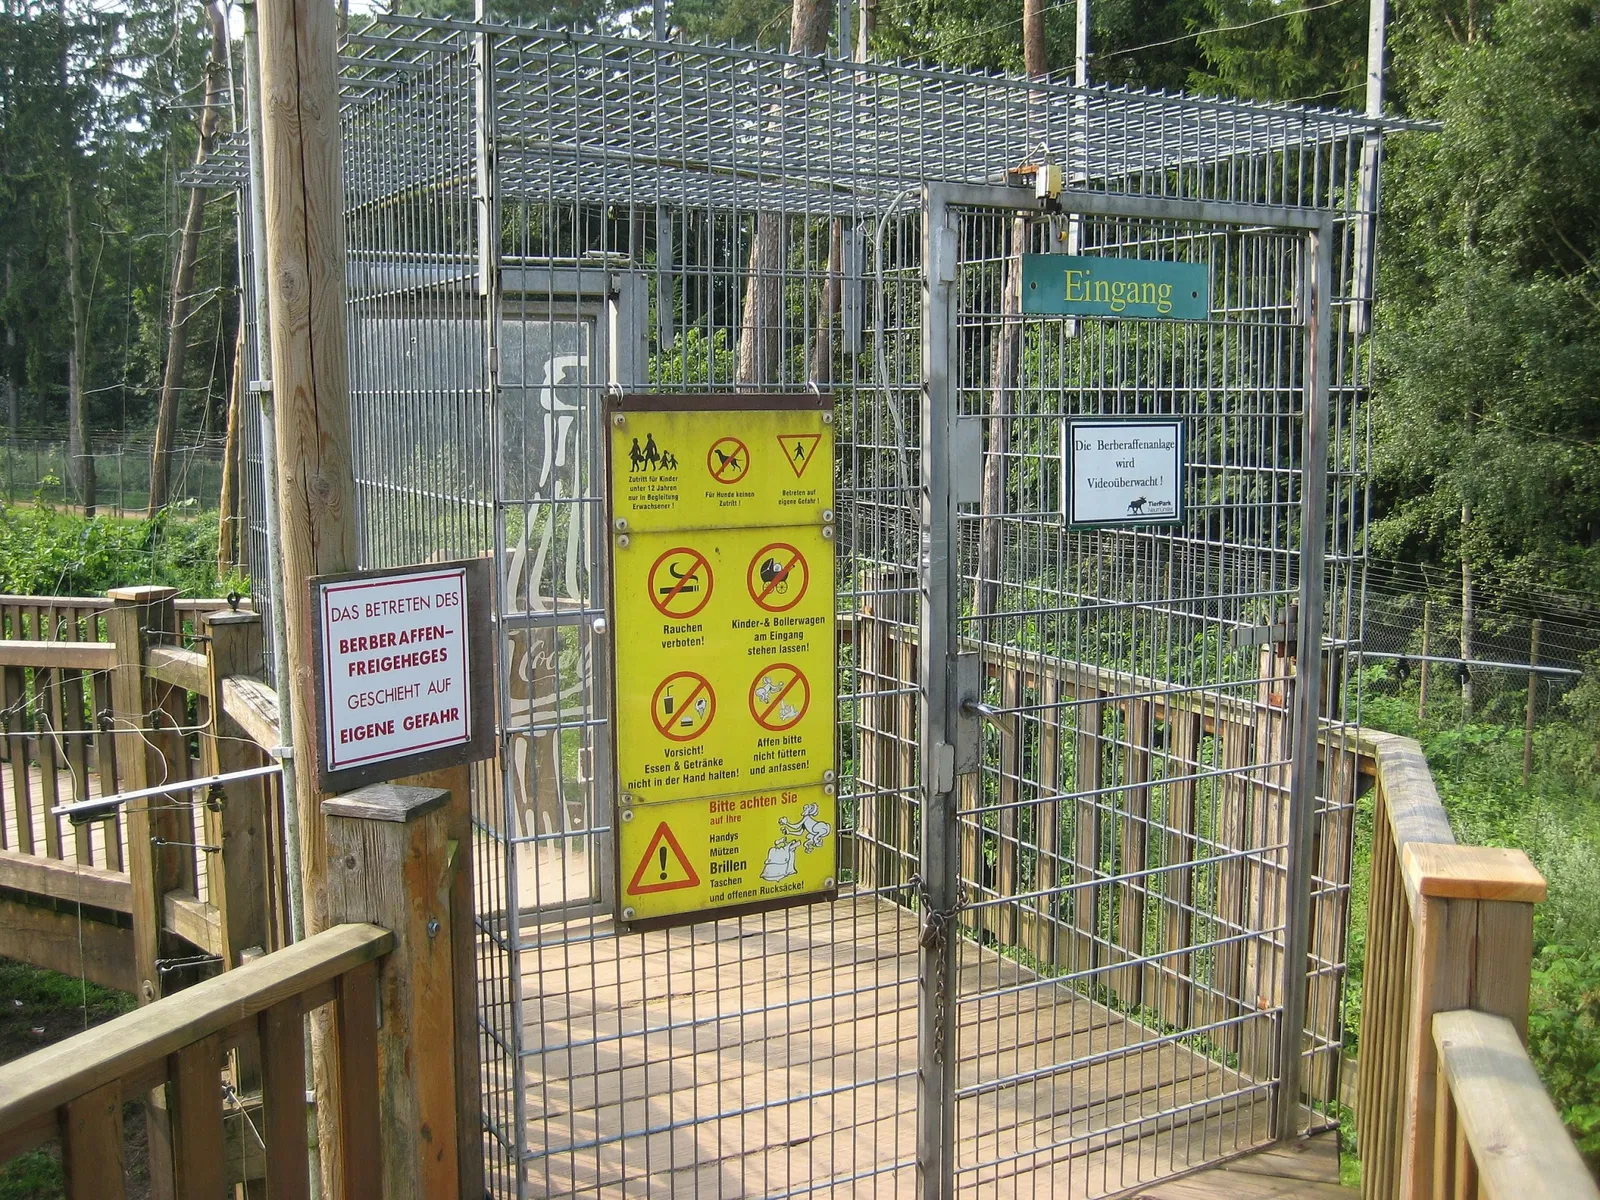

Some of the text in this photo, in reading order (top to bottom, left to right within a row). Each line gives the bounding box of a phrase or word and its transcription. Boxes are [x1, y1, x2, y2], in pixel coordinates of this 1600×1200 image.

[1064, 270, 1172, 314] Eingang
[1075, 439, 1175, 451] Die Berberaffenanlage
[1115, 458, 1135, 468] wird
[1087, 476, 1158, 488] Videoüberwacht
[647, 493, 679, 502] Begleitung
[782, 489, 805, 497] Betreten
[778, 498, 796, 506] eigene
[331, 592, 459, 622] DAS BETRETEN DES
[773, 616, 825, 627] Bollerwagen
[663, 623, 702, 634] Rauchen
[340, 625, 453, 654] BERBERAFFEN-
[661, 636, 704, 648] verboten!
[754, 631, 804, 641] am Eingang
[748, 643, 809, 655] stehen lassen!
[349, 648, 447, 677] FREIGEHEGES
[348, 678, 451, 709] GESCHIEHT AUF
[340, 708, 459, 744] EIGENE GEFAHR
[757, 735, 802, 748] Affen bitte
[664, 745, 703, 758] Vorsicht!
[753, 748, 806, 761] nicht füttern
[645, 758, 723, 774] Essen & Getränke
[750, 760, 809, 775] und anfassen!
[628, 769, 739, 789] nicht in der Hand halten!
[709, 792, 797, 813] Bitte achten Sie
[710, 814, 741, 825] auf Ihre
[709, 831, 738, 843] Handys
[710, 846, 739, 857] Mützen
[710, 859, 747, 874] Brillen
[710, 877, 742, 888] Taschen
[709, 881, 804, 902] und offenen Rucksäcke!
